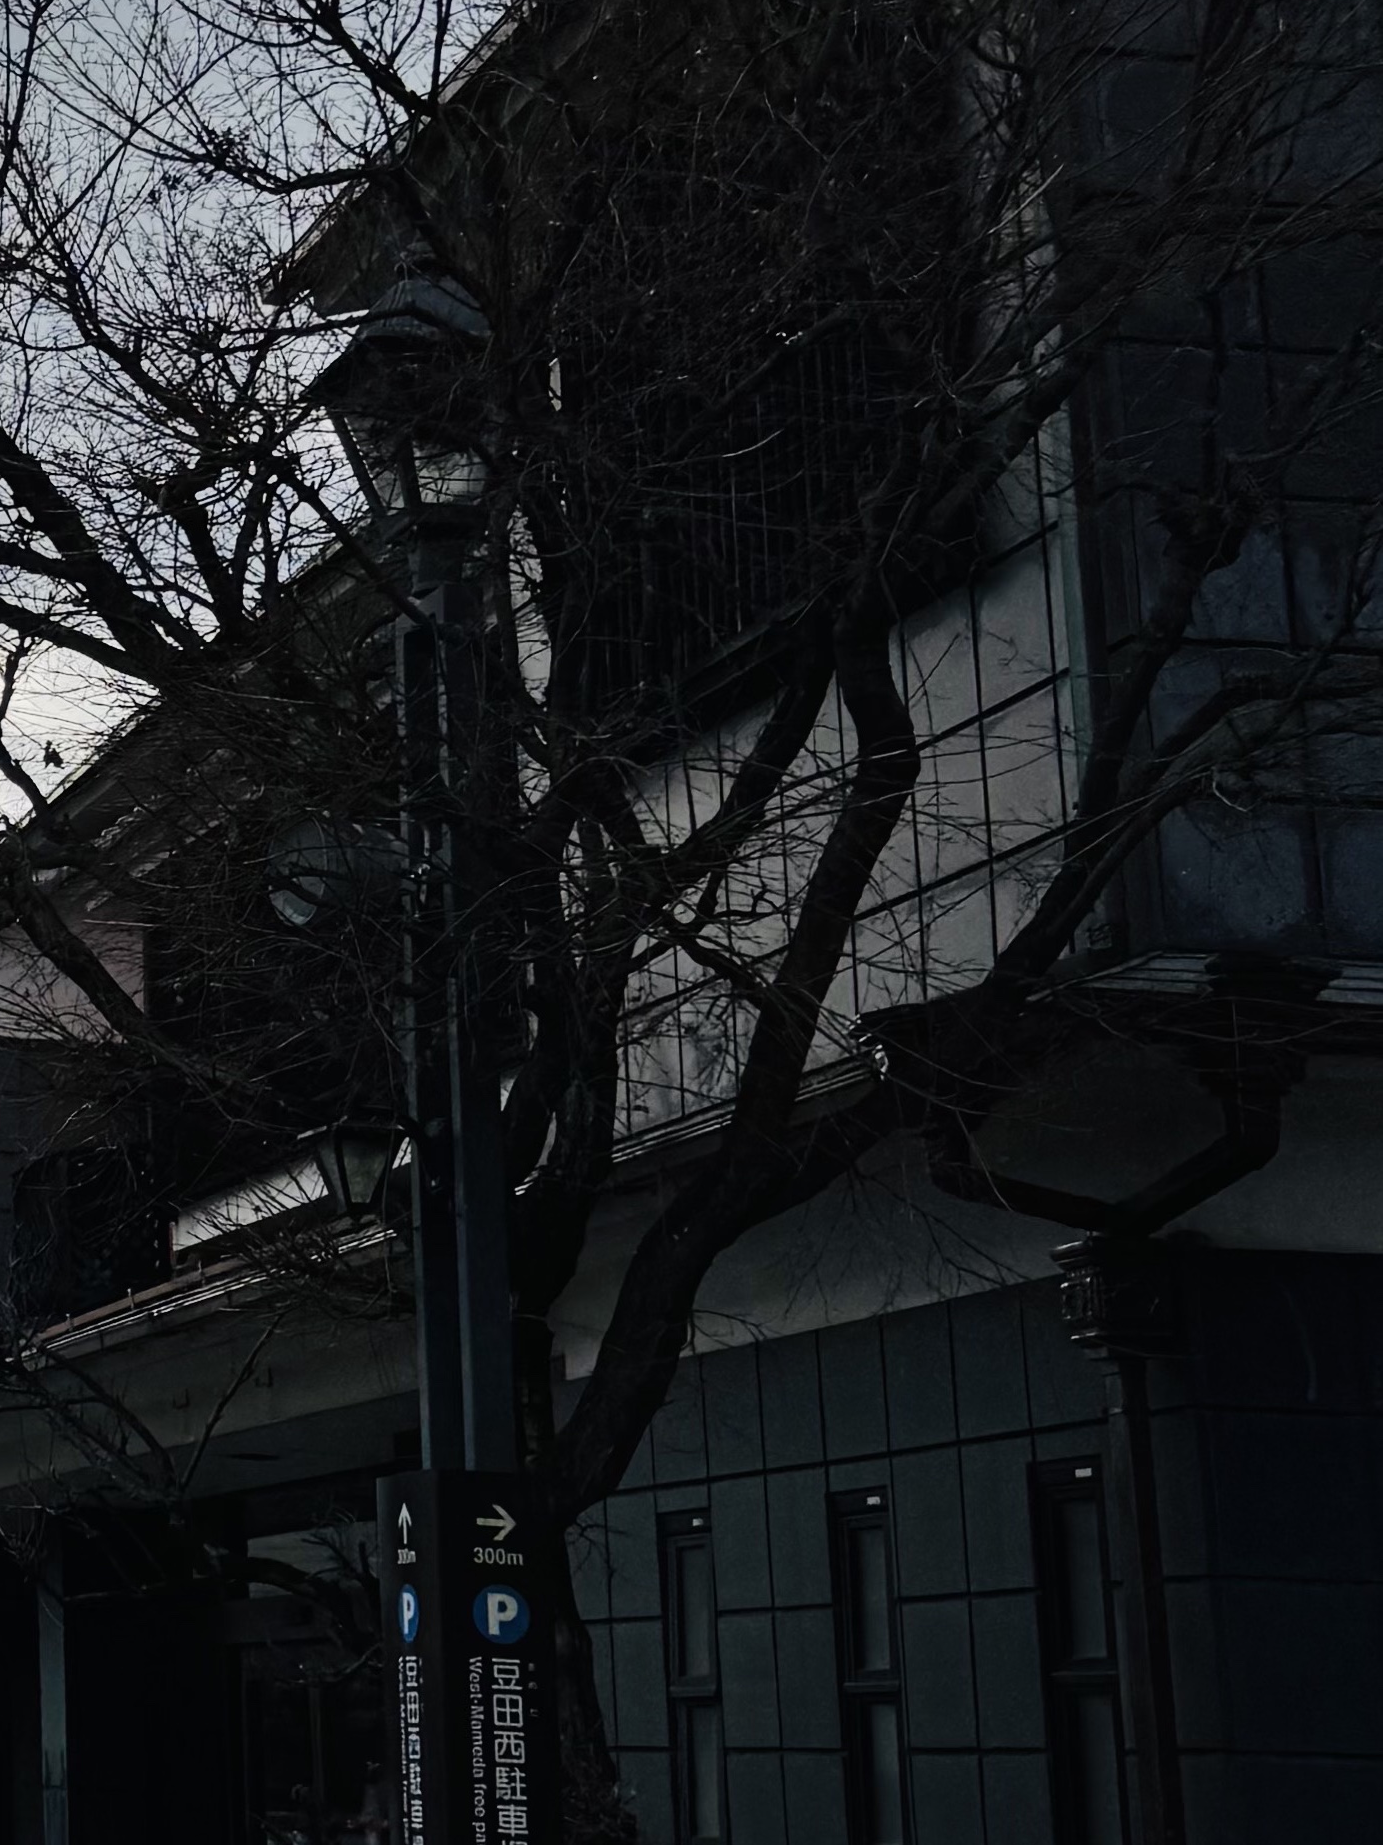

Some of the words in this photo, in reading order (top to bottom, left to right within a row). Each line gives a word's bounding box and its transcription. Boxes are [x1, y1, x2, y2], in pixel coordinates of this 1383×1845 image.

[473, 1546, 524, 1566] 300m
[402, 1591, 416, 1635] P
[487, 1592, 519, 1636] P
[474, 1783, 487, 1817] free
